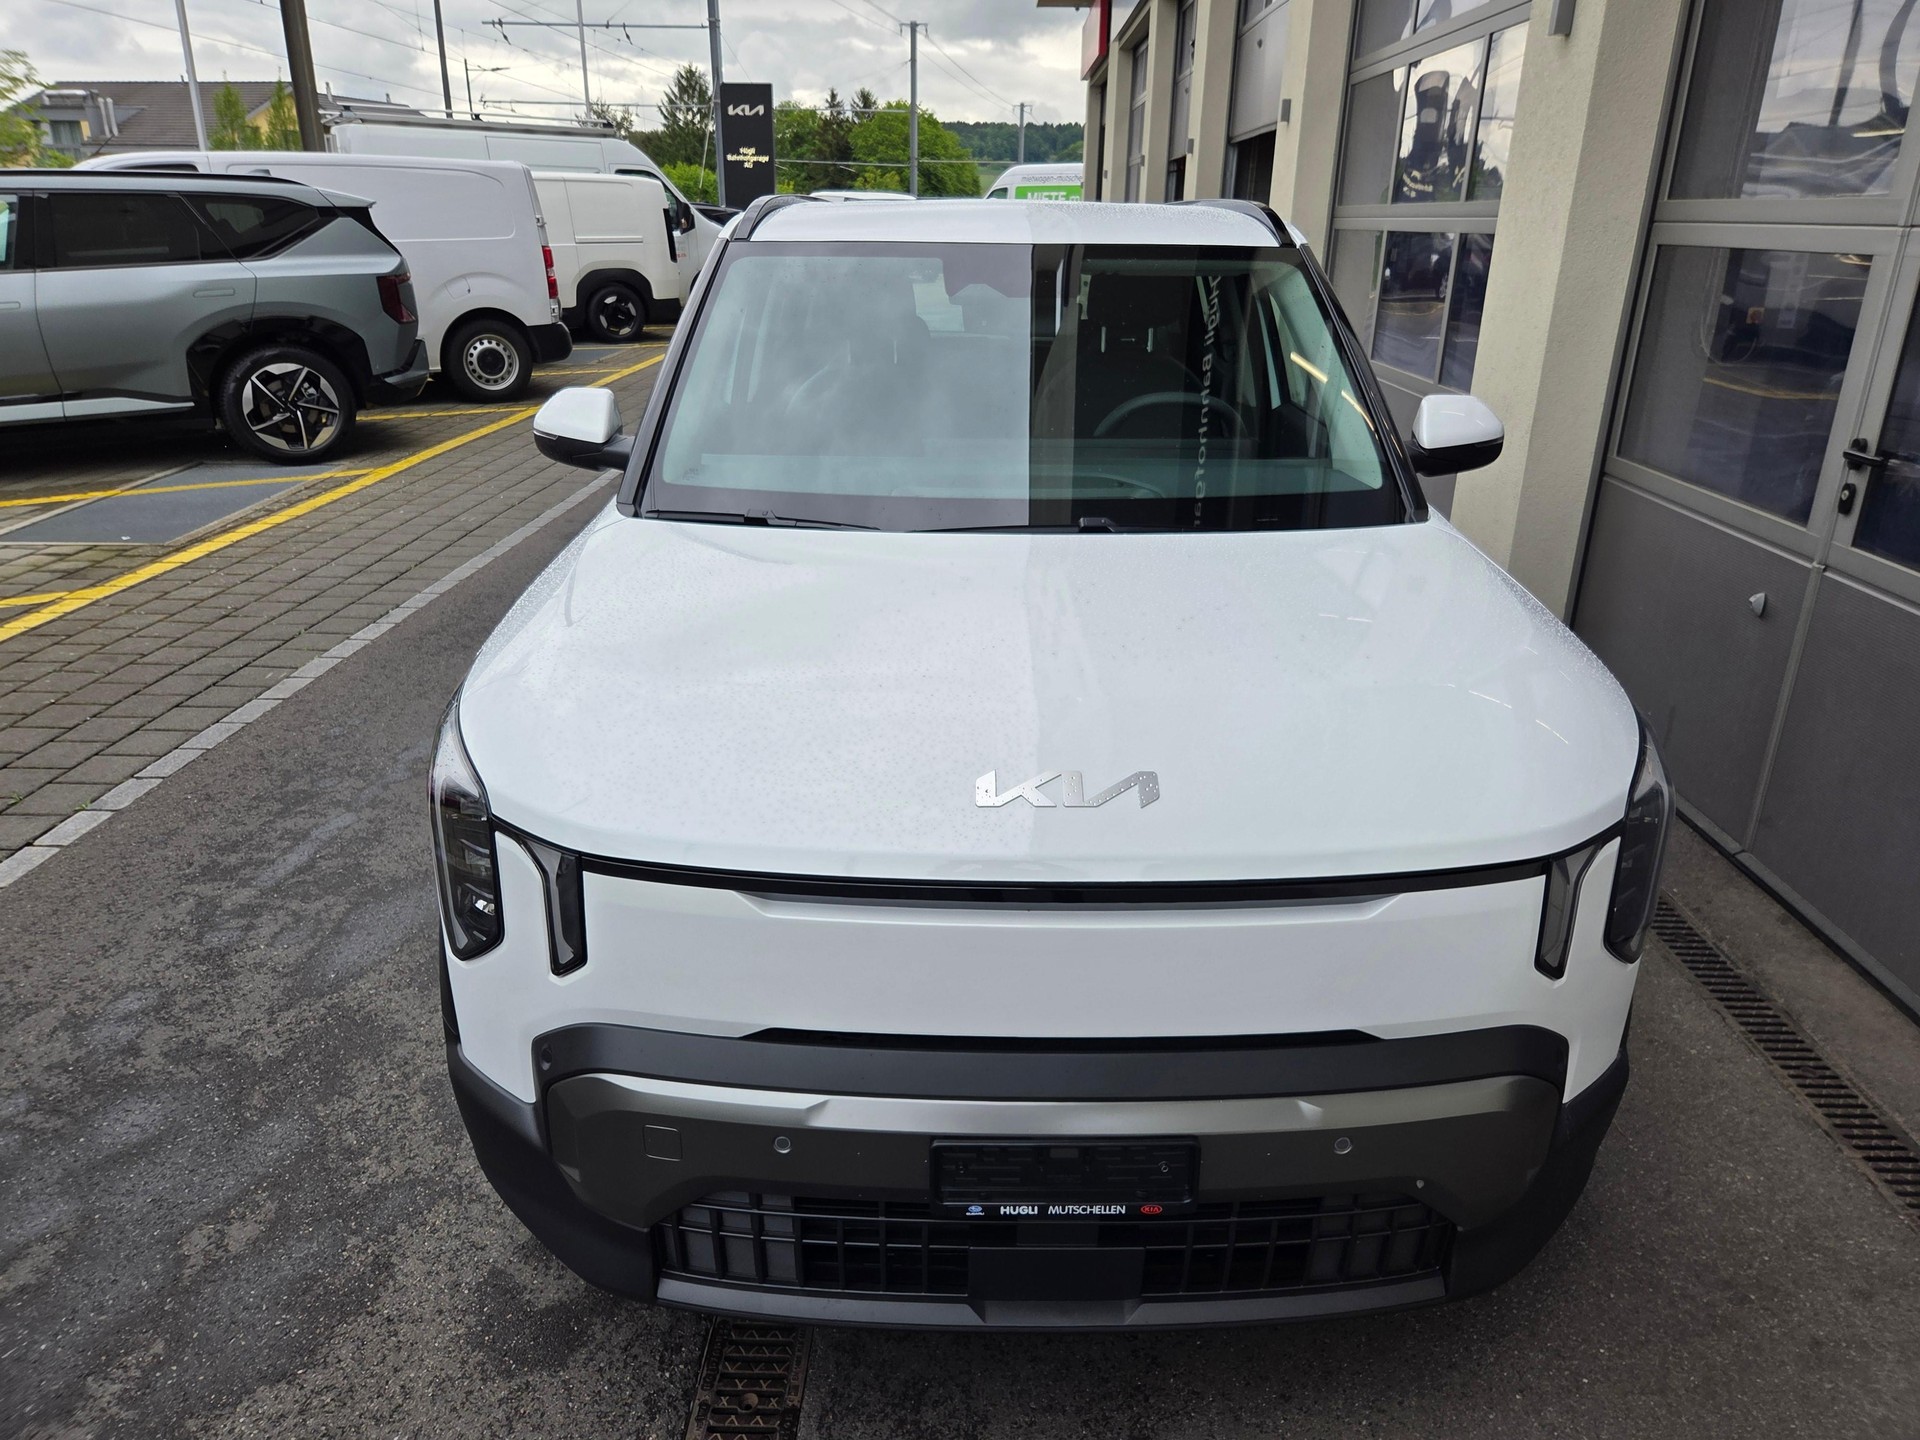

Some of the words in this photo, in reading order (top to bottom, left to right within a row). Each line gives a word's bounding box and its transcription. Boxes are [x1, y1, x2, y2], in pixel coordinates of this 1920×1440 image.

[975, 769, 1160, 808] KIA
[1000, 1205, 1038, 1215] HUGLI
[1048, 1205, 1126, 1215] MUTSCHELLEN
